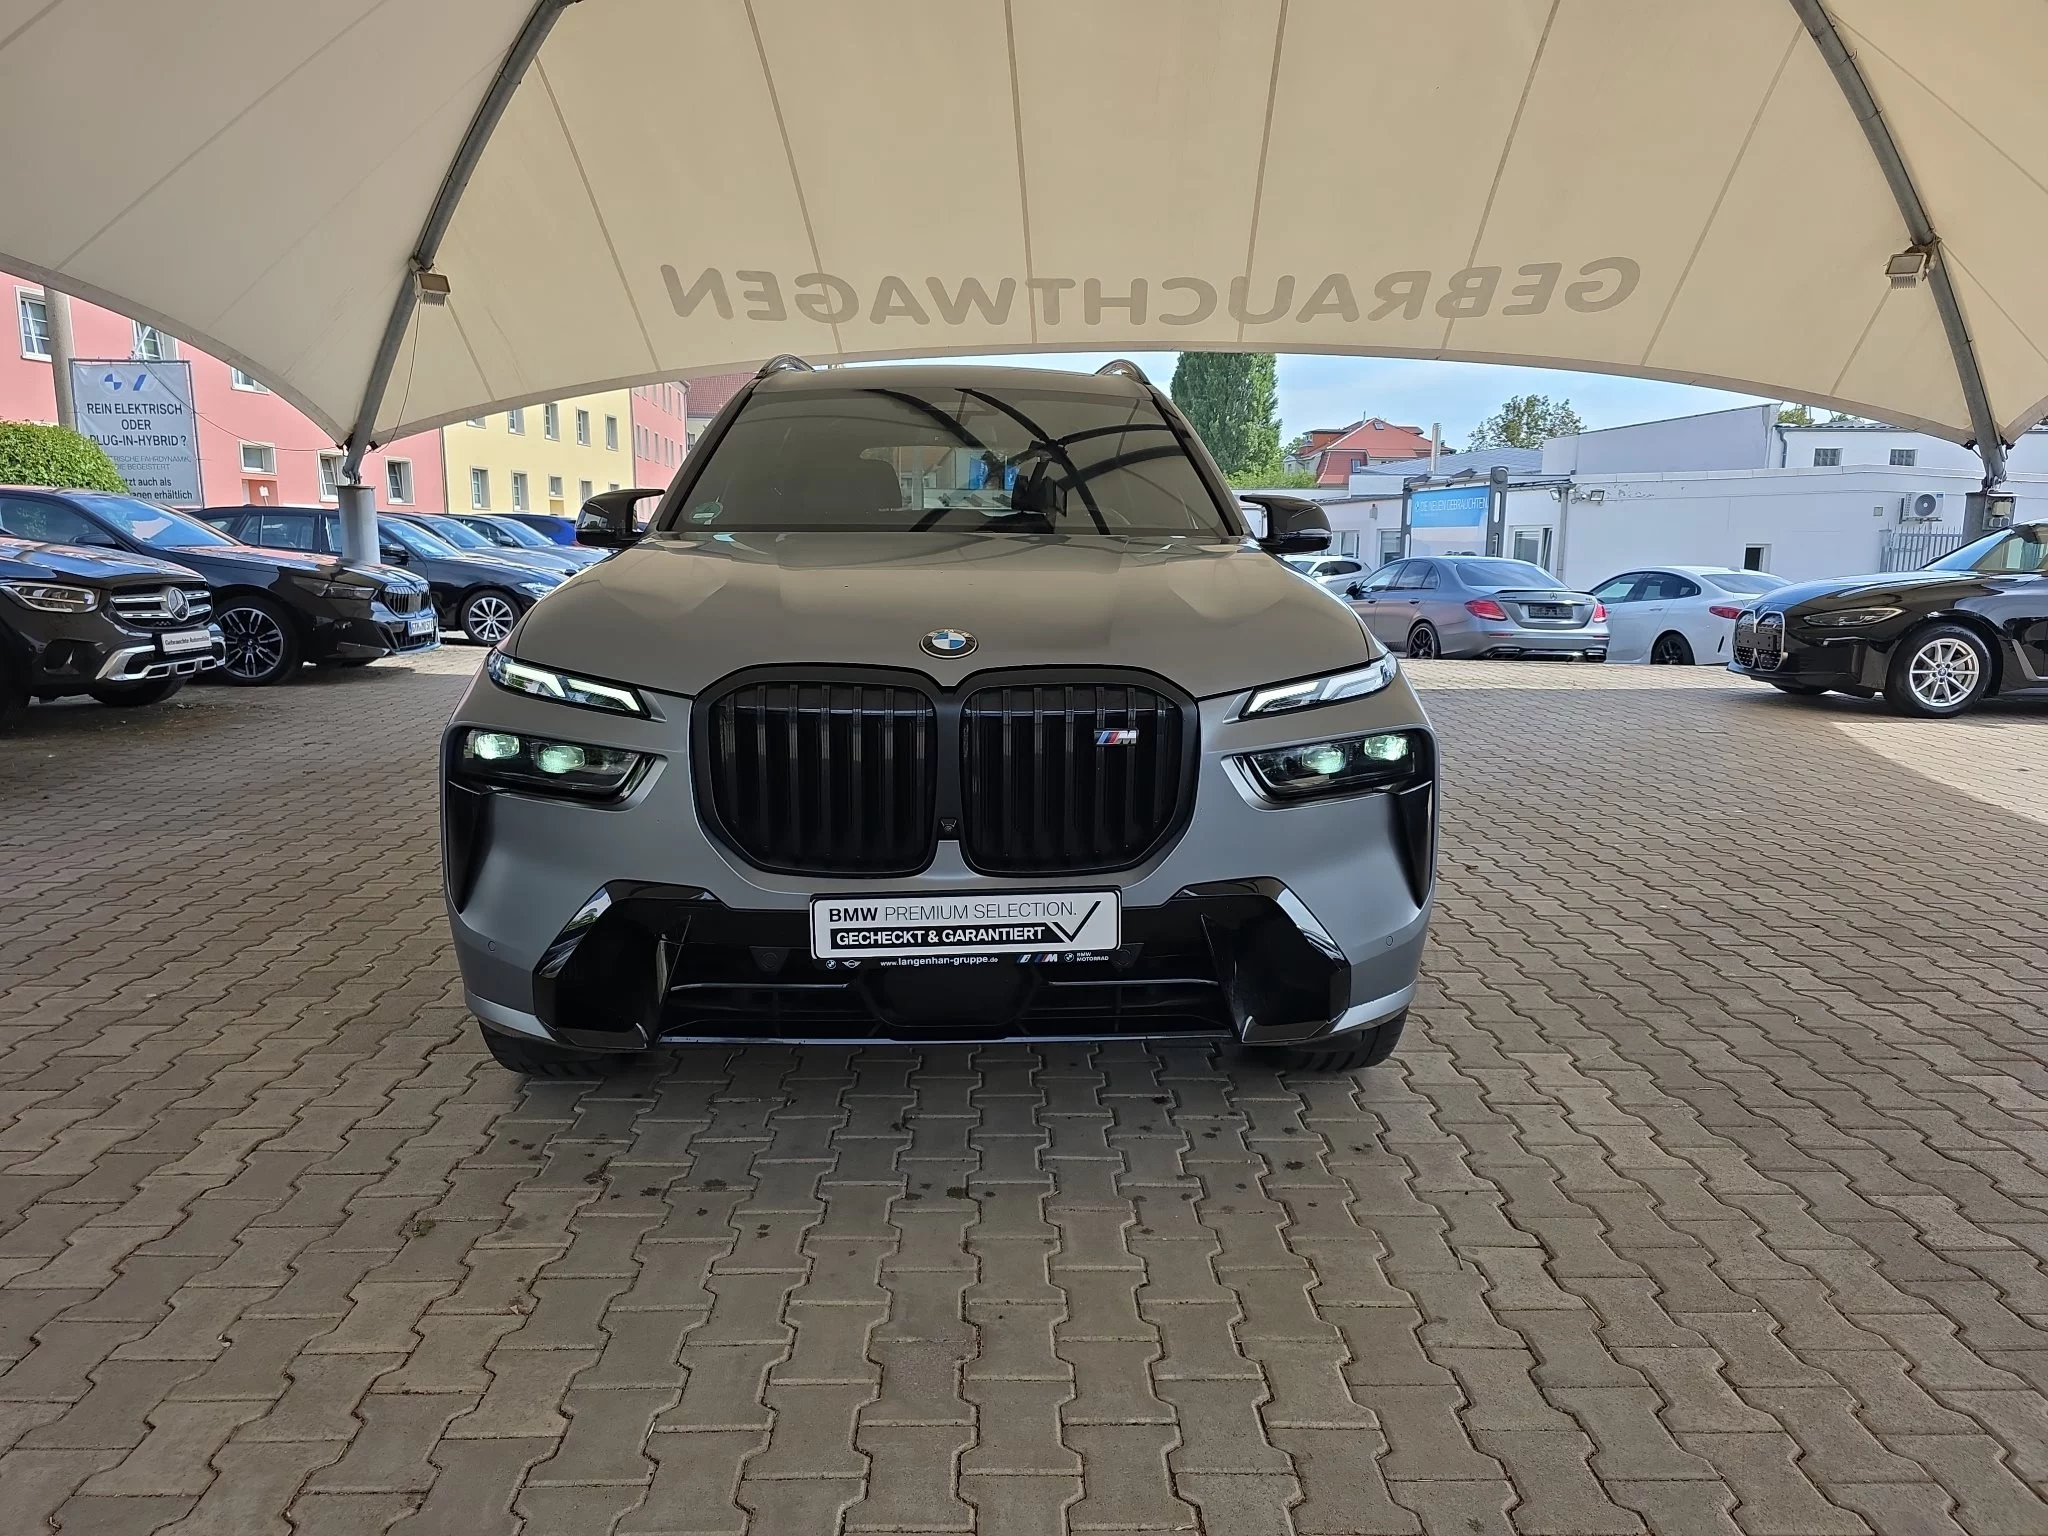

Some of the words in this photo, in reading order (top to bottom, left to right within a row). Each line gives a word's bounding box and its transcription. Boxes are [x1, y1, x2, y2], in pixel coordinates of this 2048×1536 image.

[87, 403, 112, 415] REIN
[114, 403, 183, 415] ELEKTRISCH
[121, 419, 152, 430] ODER
[138, 477, 158, 486] auch
[160, 477, 172, 486] als
[155, 490, 193, 499] erhältlich
[829, 906, 878, 922] BMW
[885, 903, 969, 921] PREMIUM
[973, 901, 1077, 919] SELECTION.
[836, 931, 923, 946] GECHECKT
[927, 930, 939, 943] &
[942, 927, 1045, 943] GARANTIERT
[880, 956, 999, 967] www.langenhan-gruppe.de
